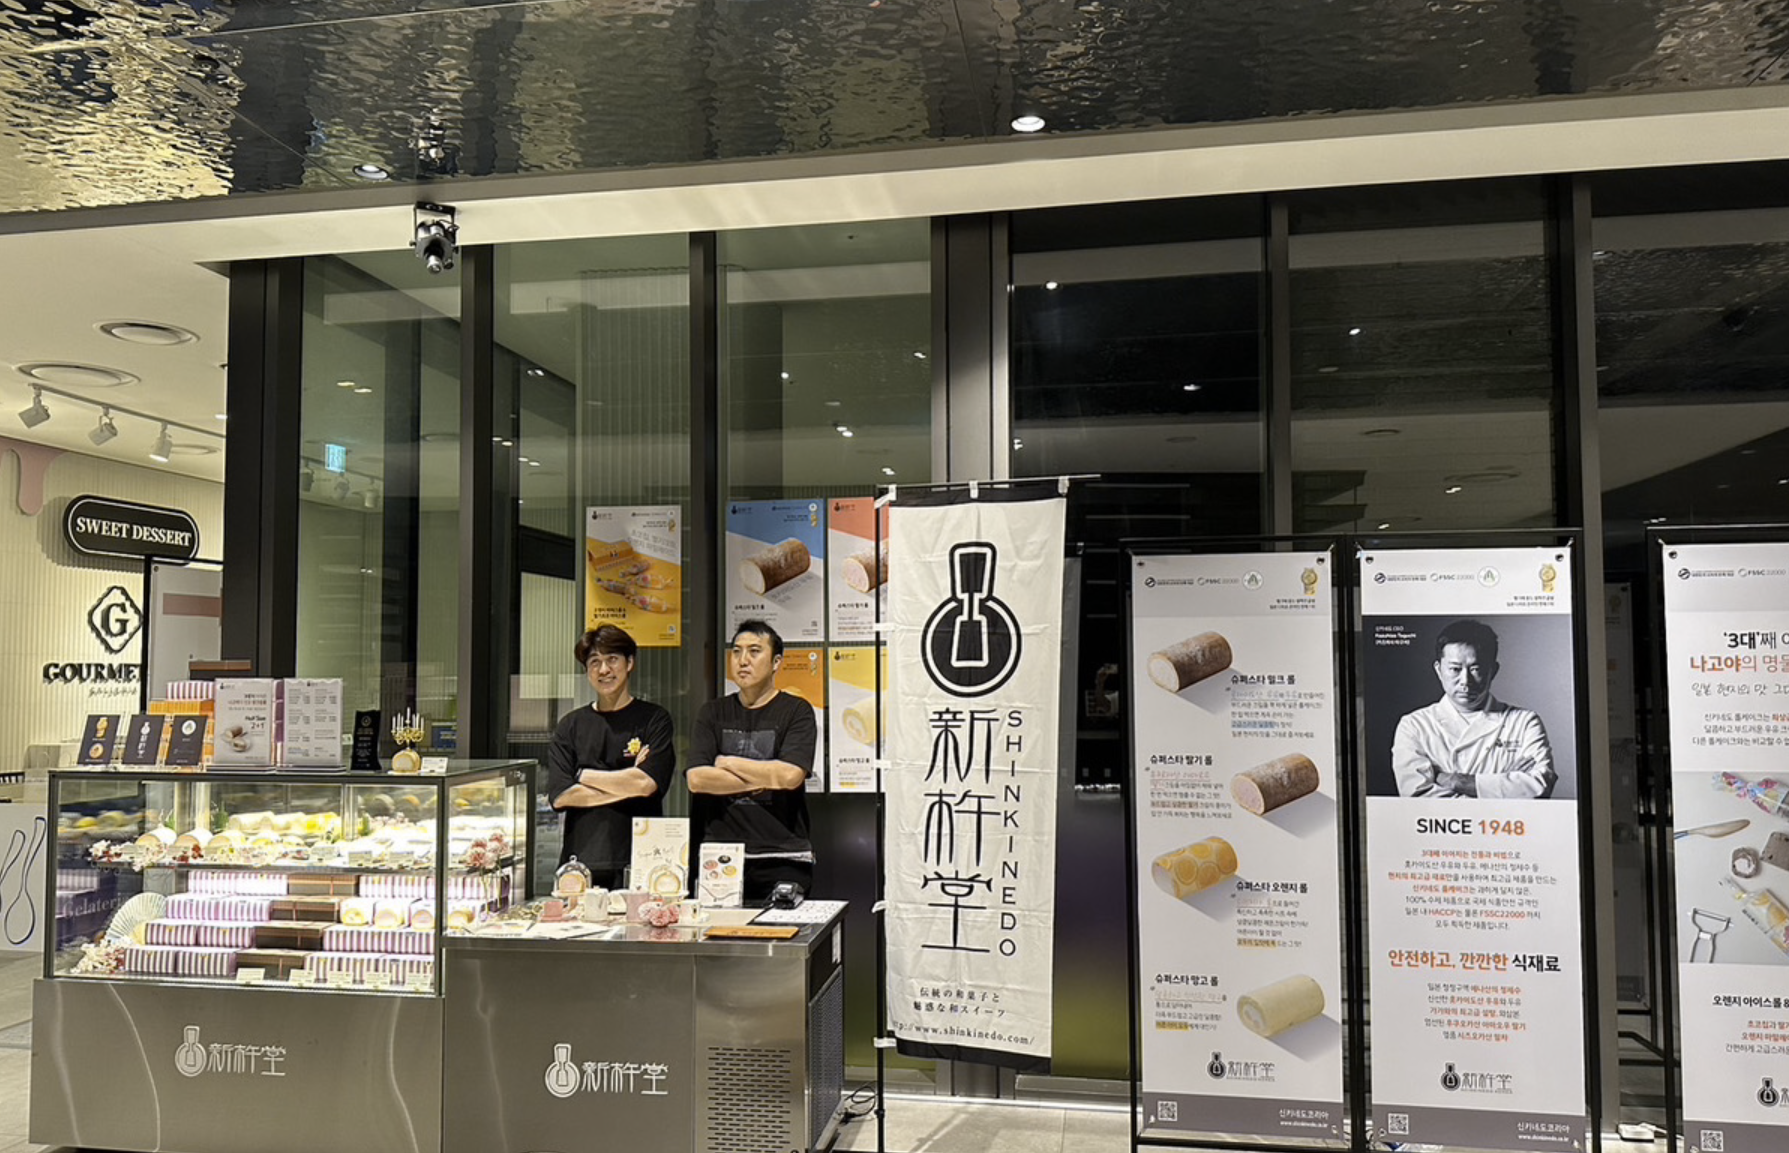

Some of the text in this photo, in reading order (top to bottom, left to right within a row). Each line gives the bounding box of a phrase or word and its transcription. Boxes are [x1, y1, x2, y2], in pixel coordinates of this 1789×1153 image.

[76, 516, 192, 546] SWEET DESSERT
[101, 603, 129, 637] G
[1690, 655, 1757, 673] 나고야의
[43, 662, 141, 681] GOURME
[1231, 675, 1295, 685] 슈퍼스타 밀크 롤
[1692, 683, 1711, 696] 일본
[1717, 683, 1750, 696] 현지의
[1755, 684, 1768, 696] 맛
[1704, 713, 1733, 722] 신키네도
[1735, 713, 1770, 723] 롤케이크는
[1151, 755, 1212, 765] 슈퍼스타 딸기 롤
[922, 707, 1001, 953] 新杵堂
[1000, 710, 1023, 956] SHINKINEDO
[1416, 818, 1525, 836] SINCE 1948
[1442, 850, 1469, 859] 이어지는
[1471, 850, 1492, 859] 전통과
[1493, 851, 1521, 859] 비법으로
[1405, 860, 1439, 869] 홋카이도산
[1440, 861, 1461, 870] 우유와
[1410, 872, 1430, 881] 최고급
[1432, 873, 1459, 882] 재료만을
[1461, 874, 1489, 882] 사용하여
[1491, 874, 1511, 883] 최고급
[1513, 875, 1534, 884] 제품을
[1535, 876, 1557, 885] 만드는
[1236, 881, 1308, 893] 슈퍼스타 오렌지 롤
[1413, 884, 1440, 893] 신키네도
[1442, 885, 1476, 894] 롤케이크는
[1405, 896, 1426, 904] 100%
[1443, 897, 1471, 905] 제품으로
[1405, 907, 1418, 916] 일본
[1479, 910, 1525, 918] FSSC22000
[1435, 920, 1449, 928] 모두
[1388, 949, 1561, 972] 안전하고, 깐깐한 식재료
[1155, 974, 1218, 986] 슈퍼스타 망고 롤
[1427, 983, 1441, 992] 일본
[1450, 996, 1484, 1006] 홋카이도산
[1713, 995, 1742, 1007] 오렌지
[1742, 996, 1782, 1009] 아이스롤
[1460, 1008, 1481, 1017] 최고급
[1742, 1032, 1763, 1041] 오렌지
[1726, 1044, 1755, 1053] 간편하게
[581, 1061, 669, 1095] 新杵堂
[1279, 1108, 1329, 1120] 신키네도코리아
[1517, 1121, 1570, 1133] 신키네도코리아
